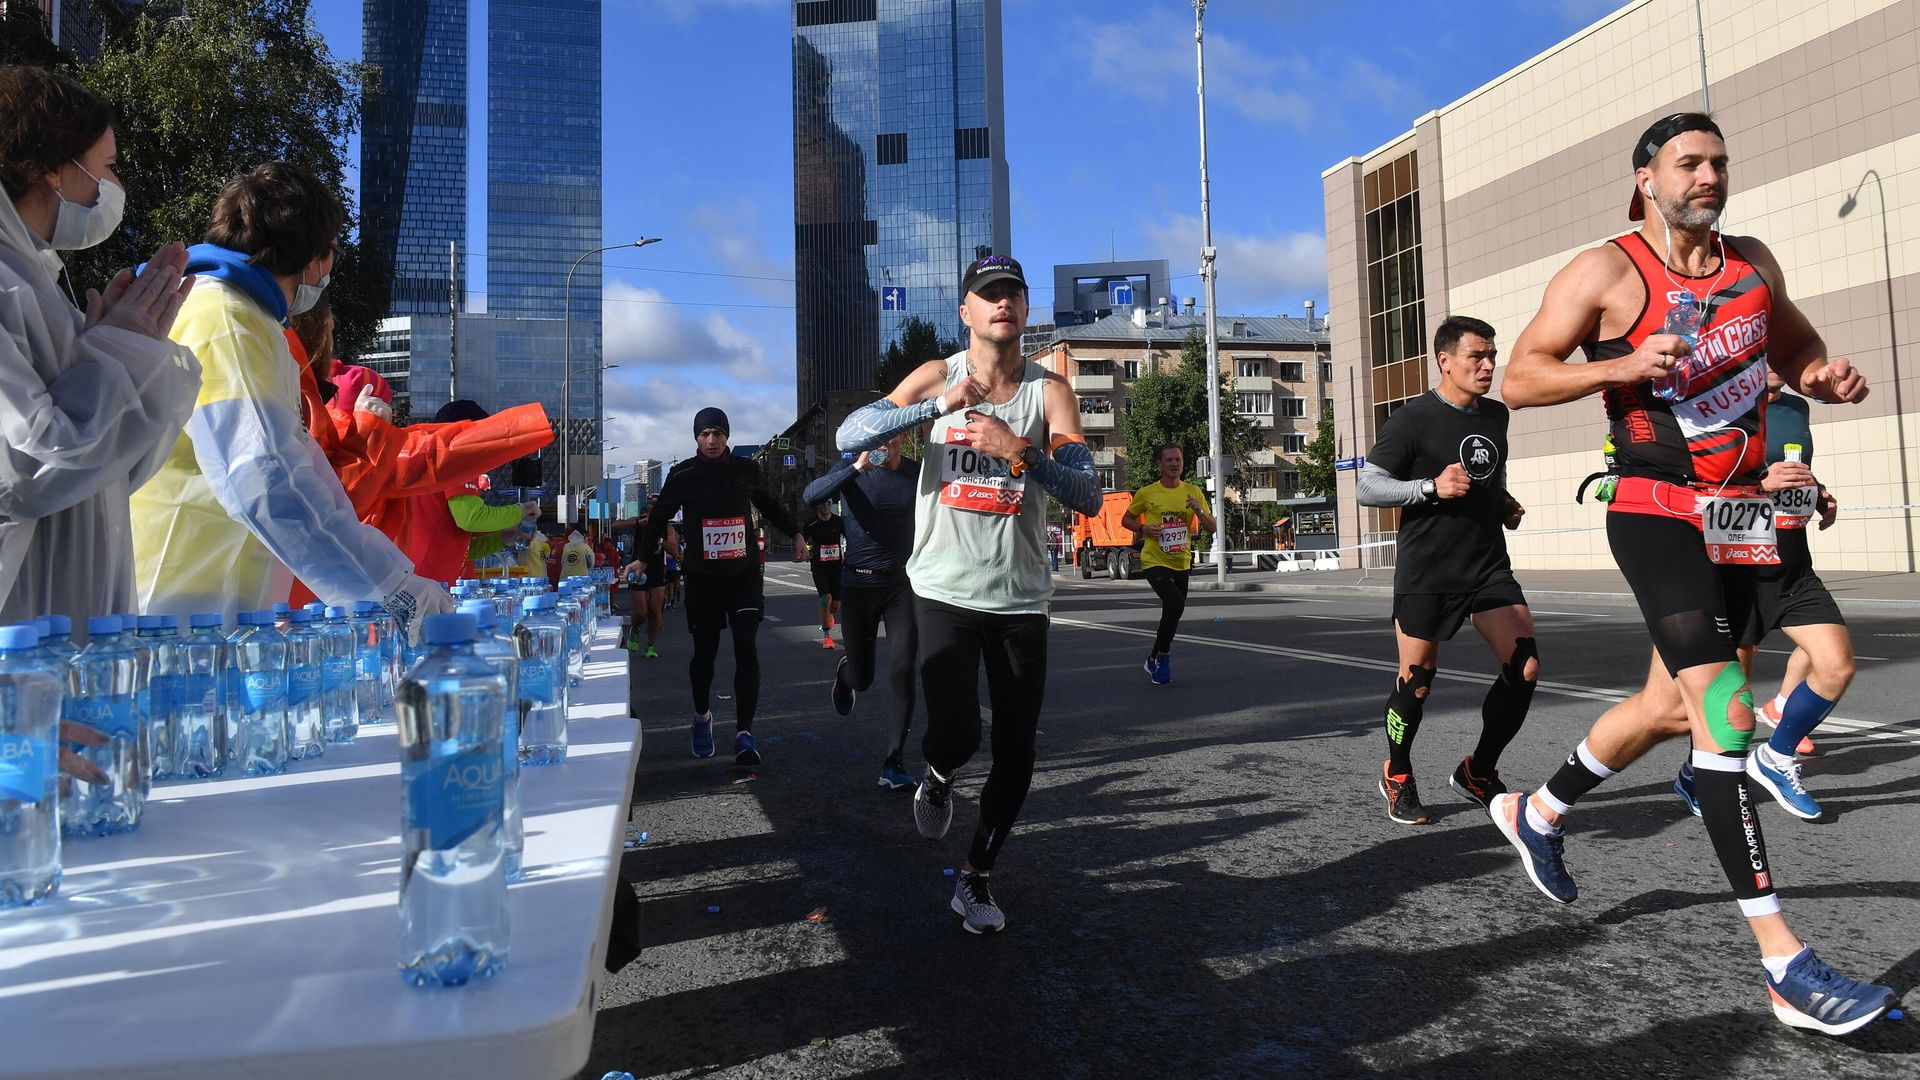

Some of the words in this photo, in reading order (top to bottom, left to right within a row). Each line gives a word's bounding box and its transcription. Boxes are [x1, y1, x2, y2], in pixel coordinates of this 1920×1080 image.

[1724, 313, 1768, 354] Class
[1695, 368, 1764, 418] RUSSIA
[957, 475, 1009, 488] КОНСТАНТИН
[950, 483, 961, 498] D
[1706, 501, 1773, 531] 10279
[706, 531, 744, 546] 12719
[1160, 530, 1187, 542] 12937
[1727, 533, 1747, 542] ОЛЕГ
[1730, 549, 1749, 558] asics
[247, 675, 281, 689] AQUA
